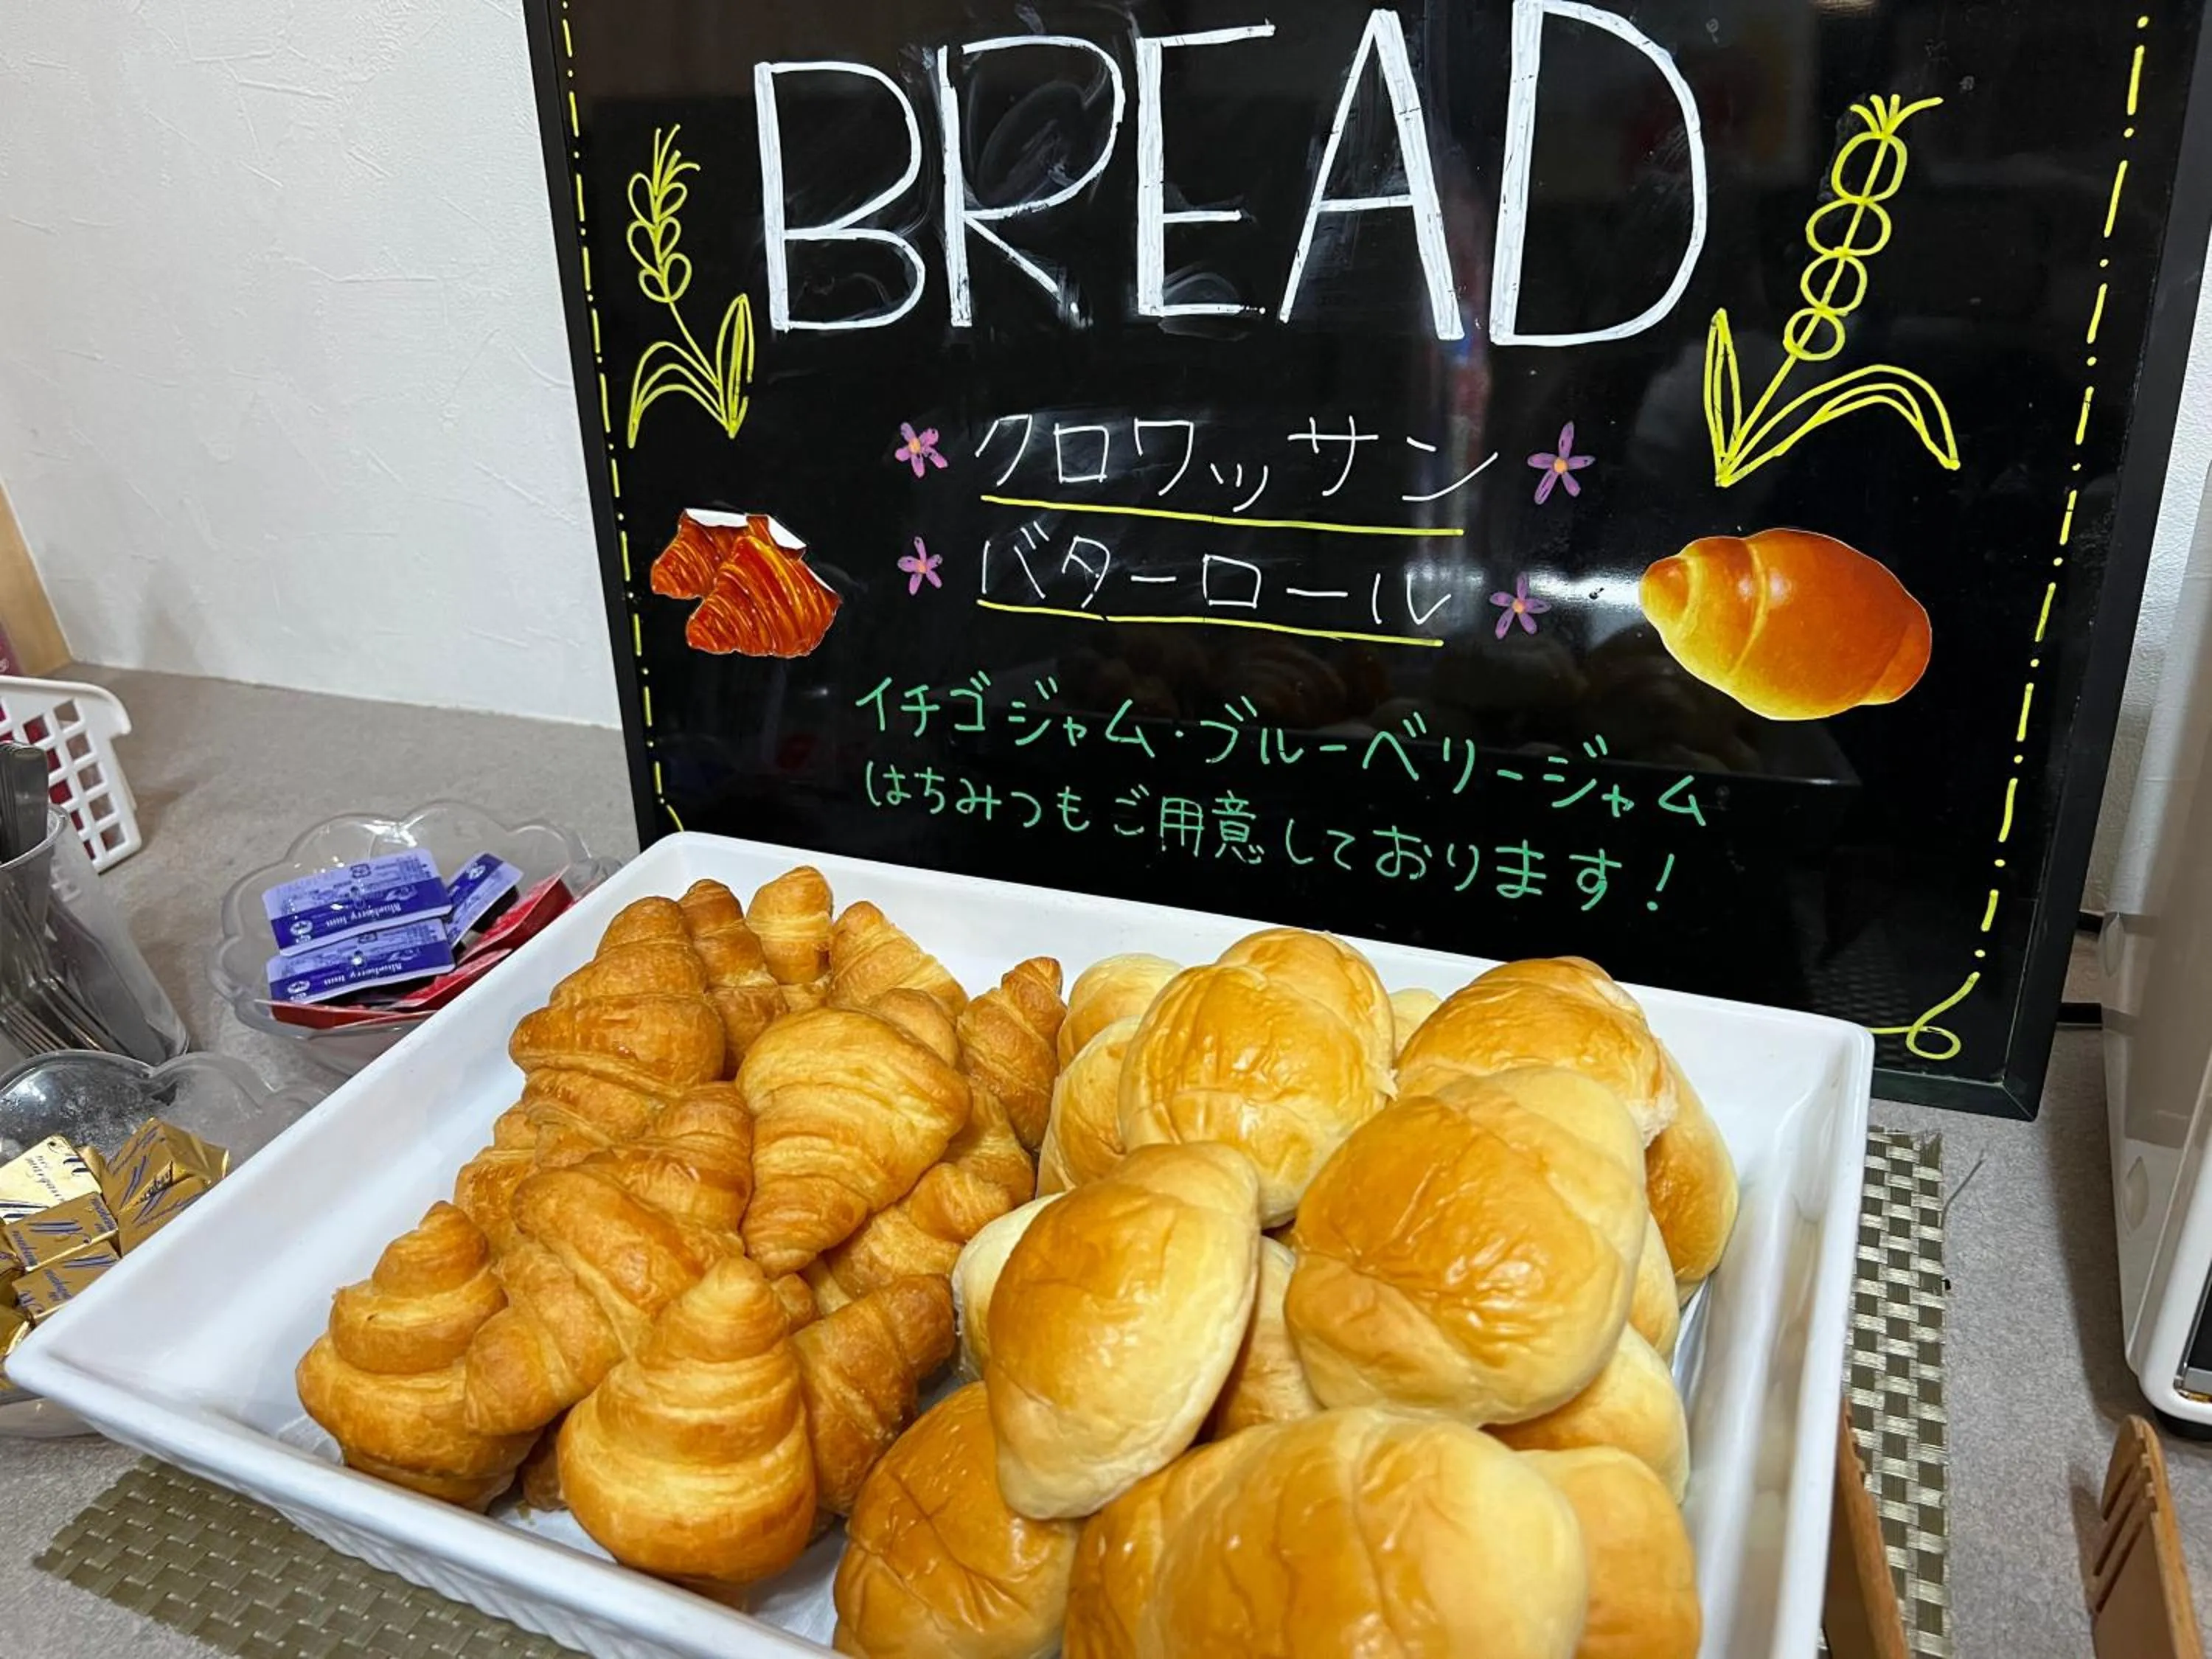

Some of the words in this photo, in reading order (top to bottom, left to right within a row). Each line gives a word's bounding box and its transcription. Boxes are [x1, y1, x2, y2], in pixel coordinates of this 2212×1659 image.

[752, 0, 1709, 345] BREAD
[975, 414, 1499, 512] クロワッサン
[979, 521, 1452, 626] バターロール
